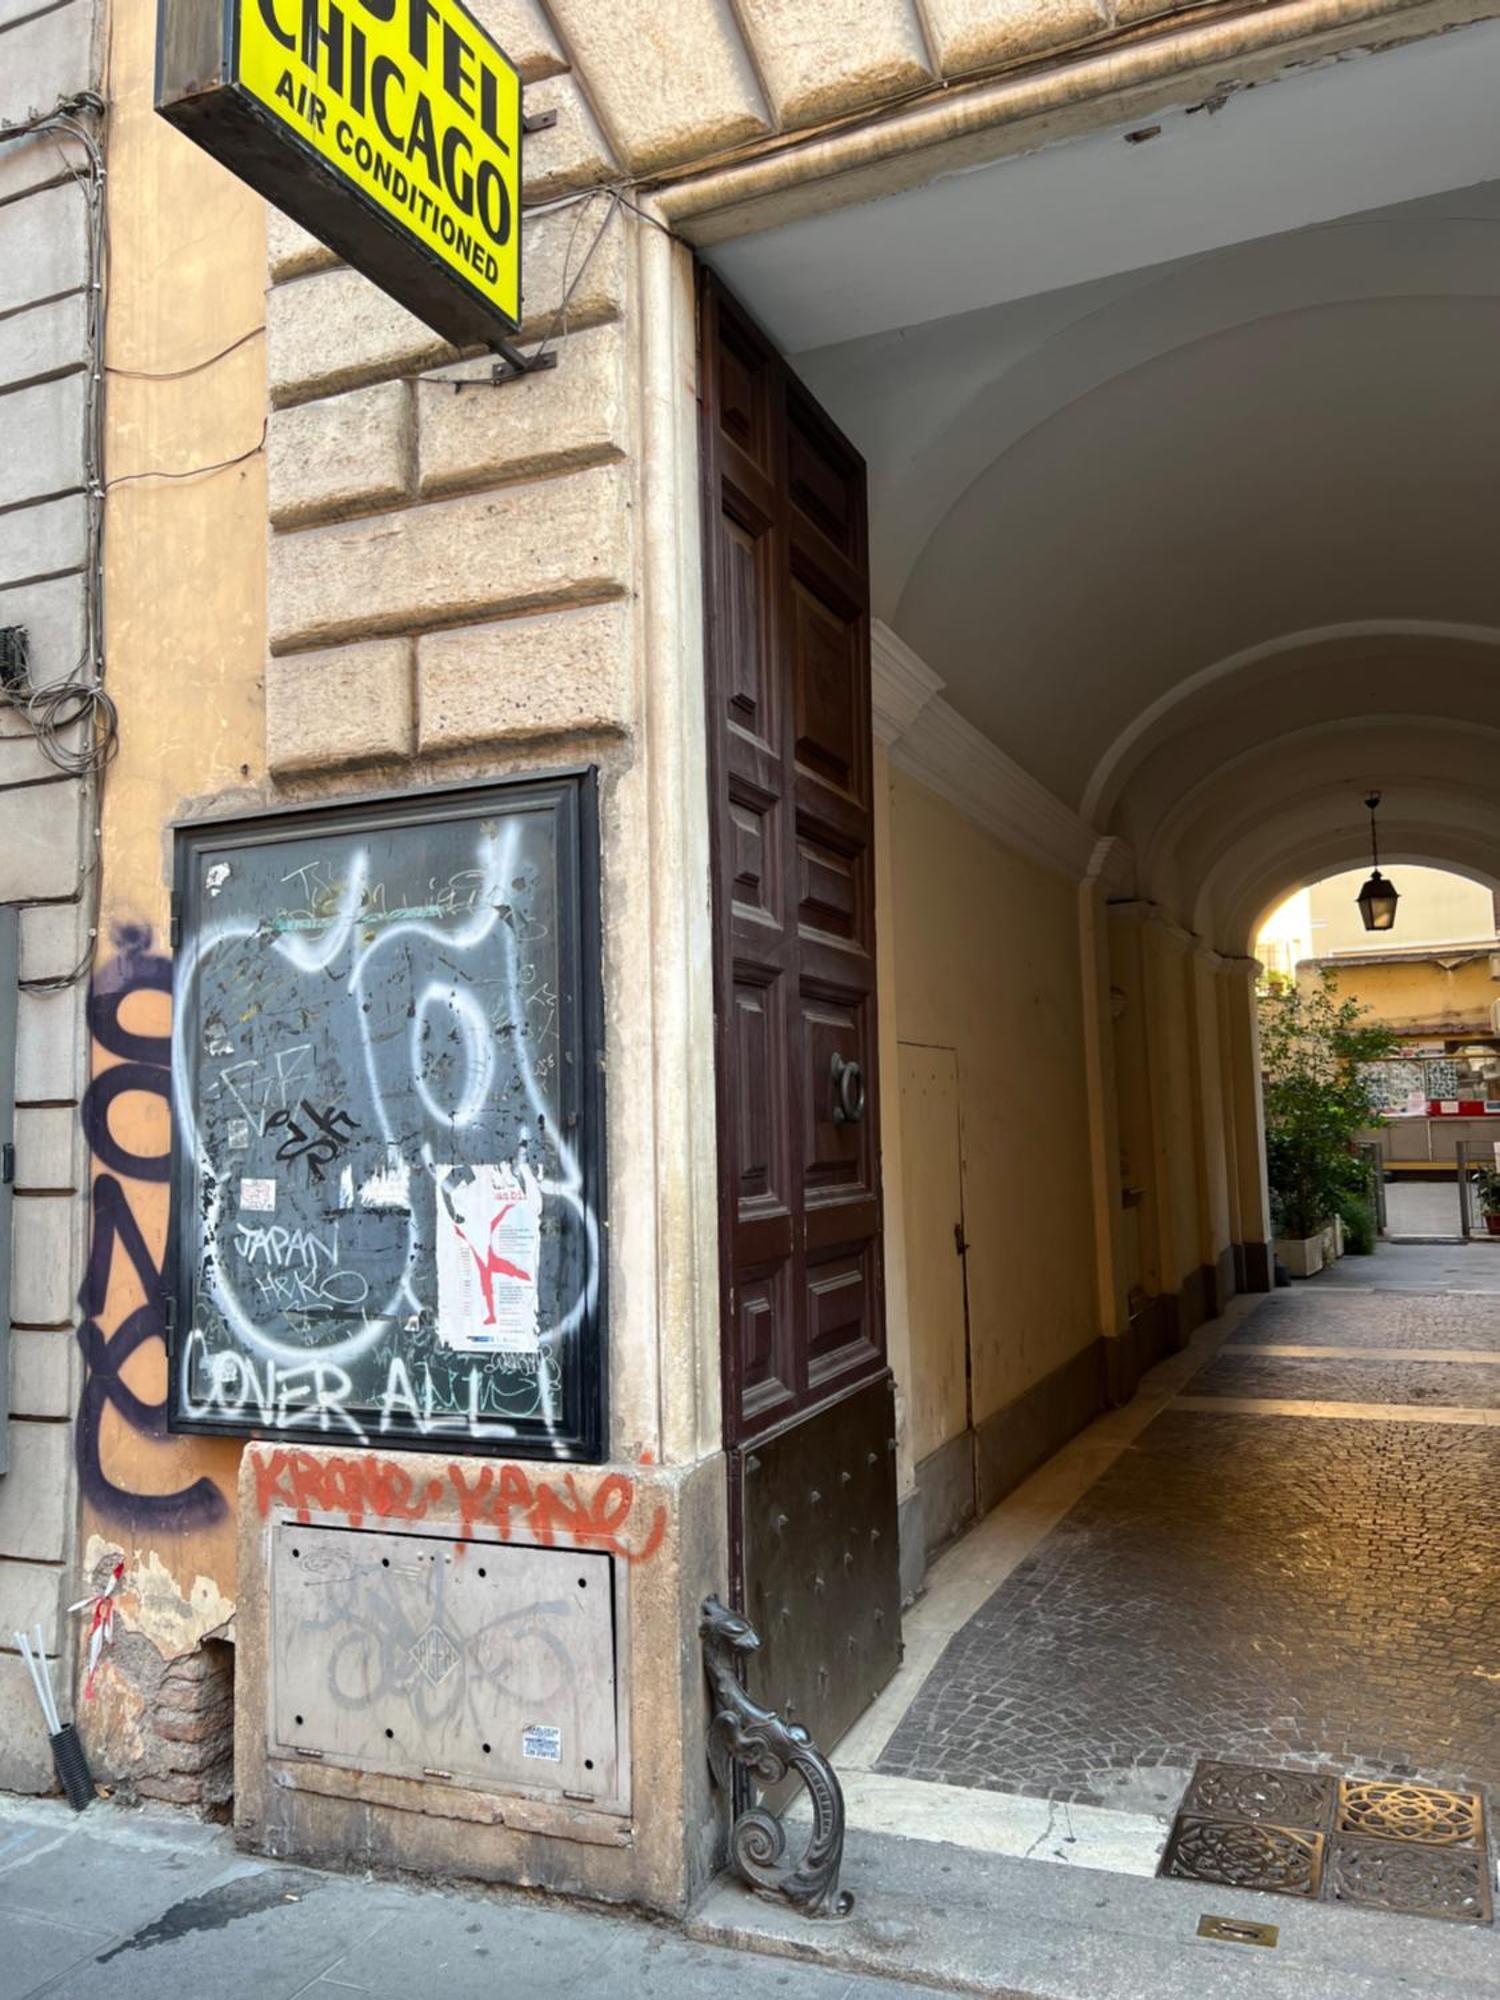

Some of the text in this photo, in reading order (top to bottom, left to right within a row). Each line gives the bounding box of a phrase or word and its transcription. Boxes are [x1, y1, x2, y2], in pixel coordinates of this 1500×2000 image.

[357, 0, 510, 157] TEL
[275, 69, 499, 285] AIR CONDITIONED
[234, 1222, 340, 1267] JAPAN
